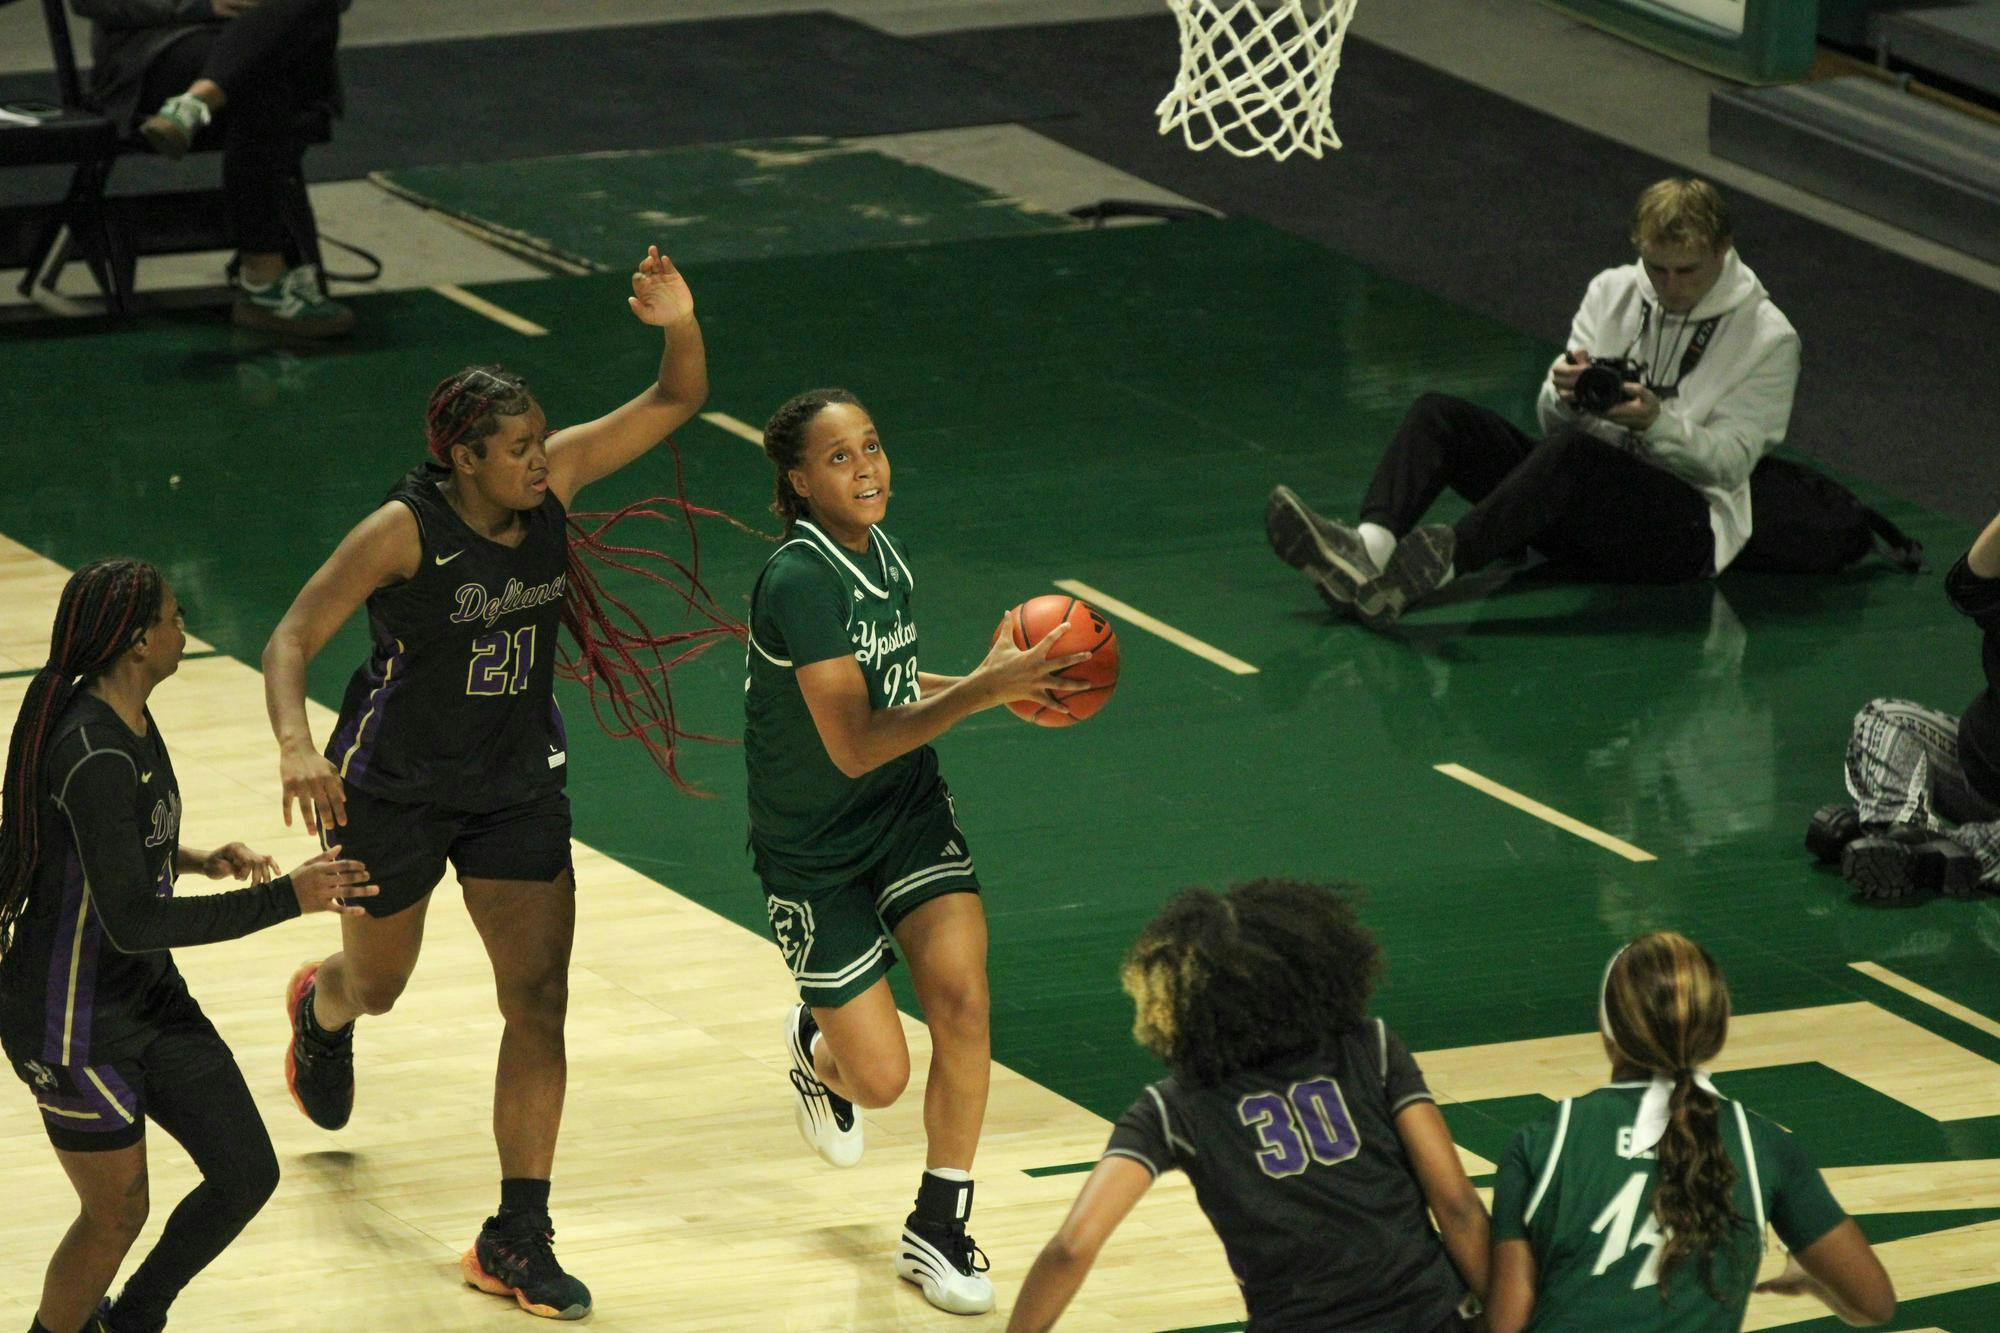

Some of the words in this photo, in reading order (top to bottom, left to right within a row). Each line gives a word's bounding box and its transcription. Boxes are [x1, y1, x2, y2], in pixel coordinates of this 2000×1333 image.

[466, 625, 536, 695] 21
[884, 656, 921, 708] 23
[1237, 1075, 1361, 1179] 30
[1590, 1171, 1676, 1290] 14
